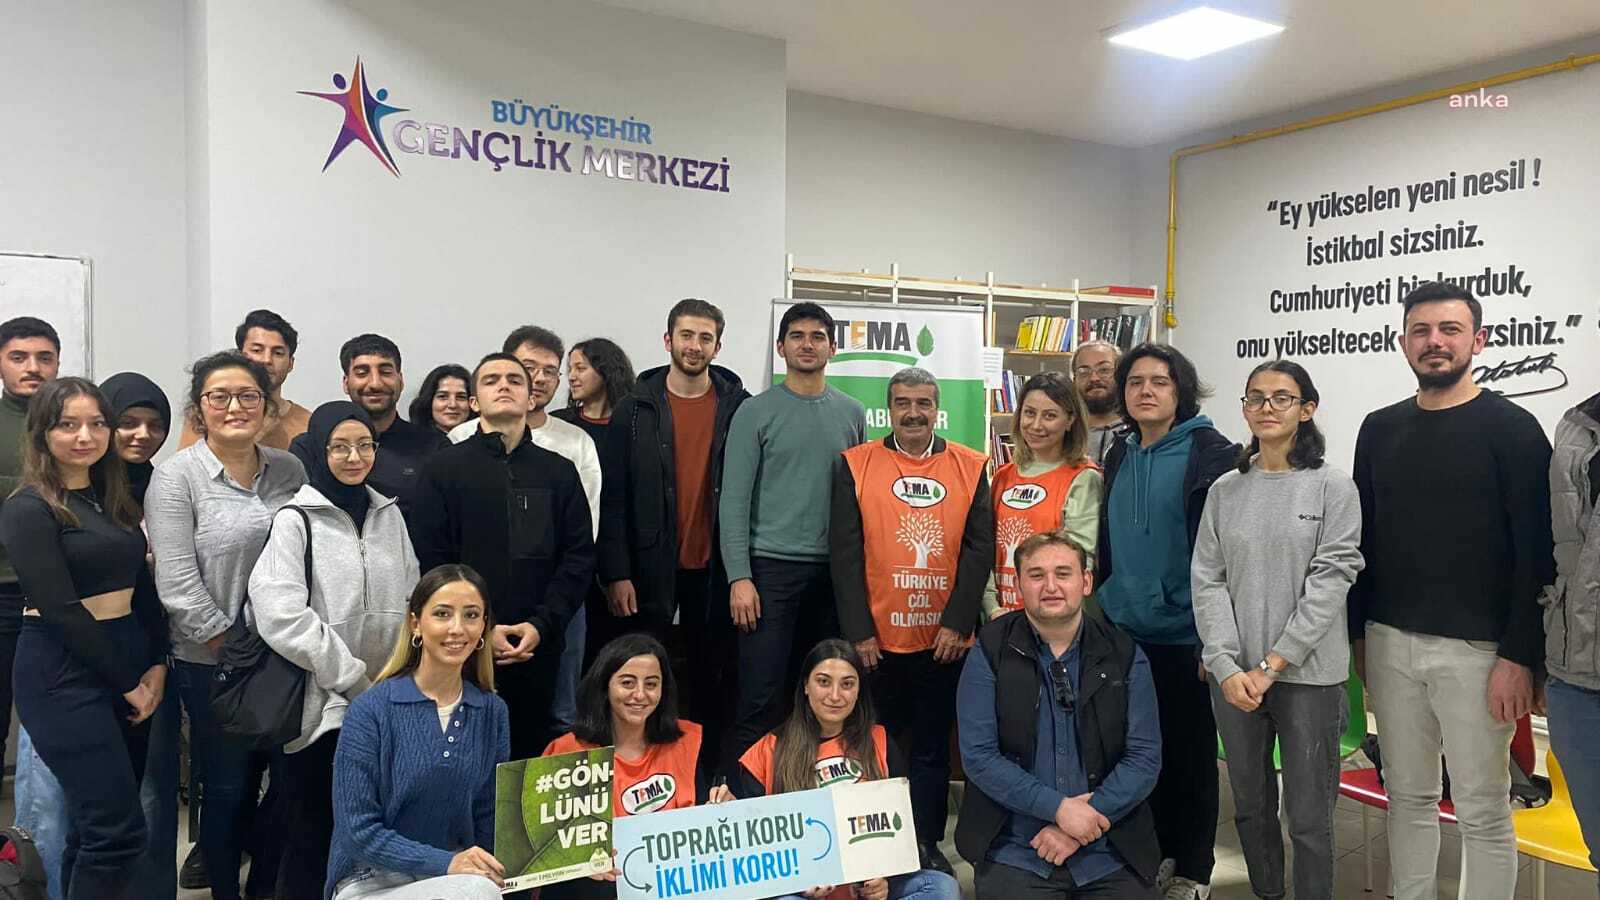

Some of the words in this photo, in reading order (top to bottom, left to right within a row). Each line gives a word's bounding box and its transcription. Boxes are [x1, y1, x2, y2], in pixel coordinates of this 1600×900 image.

[491, 99, 652, 144] BÜYÜKŞEHİR
[393, 119, 572, 174] GENÇLİK
[581, 145, 731, 193] MERKEZİ
[1308, 185, 1401, 227] yükselen
[1407, 172, 1456, 212] yeni
[1463, 159, 1525, 197] nesil
[1306, 230, 1384, 266] İstikbal
[1390, 220, 1484, 257] sizsiniz.
[1270, 278, 1391, 314] Cumhuriyeti
[1398, 273, 1430, 303] bi
[833, 320, 911, 351] TEMA
[1237, 338, 1269, 358] onu
[1274, 325, 1397, 361] yükseltecek
[892, 571, 948, 590] TÜRKİYE
[908, 591, 931, 611] ÇÖL
[540, 787, 609, 824] LÜNÜ
[632, 780, 664, 803] TEMA
[558, 821, 608, 849] VER
[642, 817, 741, 863] TOPRAĞI
[748, 812, 804, 847] KORU
[848, 812, 891, 835] TEMA
[656, 854, 727, 900] İKLİMİ
[733, 848, 799, 887] KORU!
